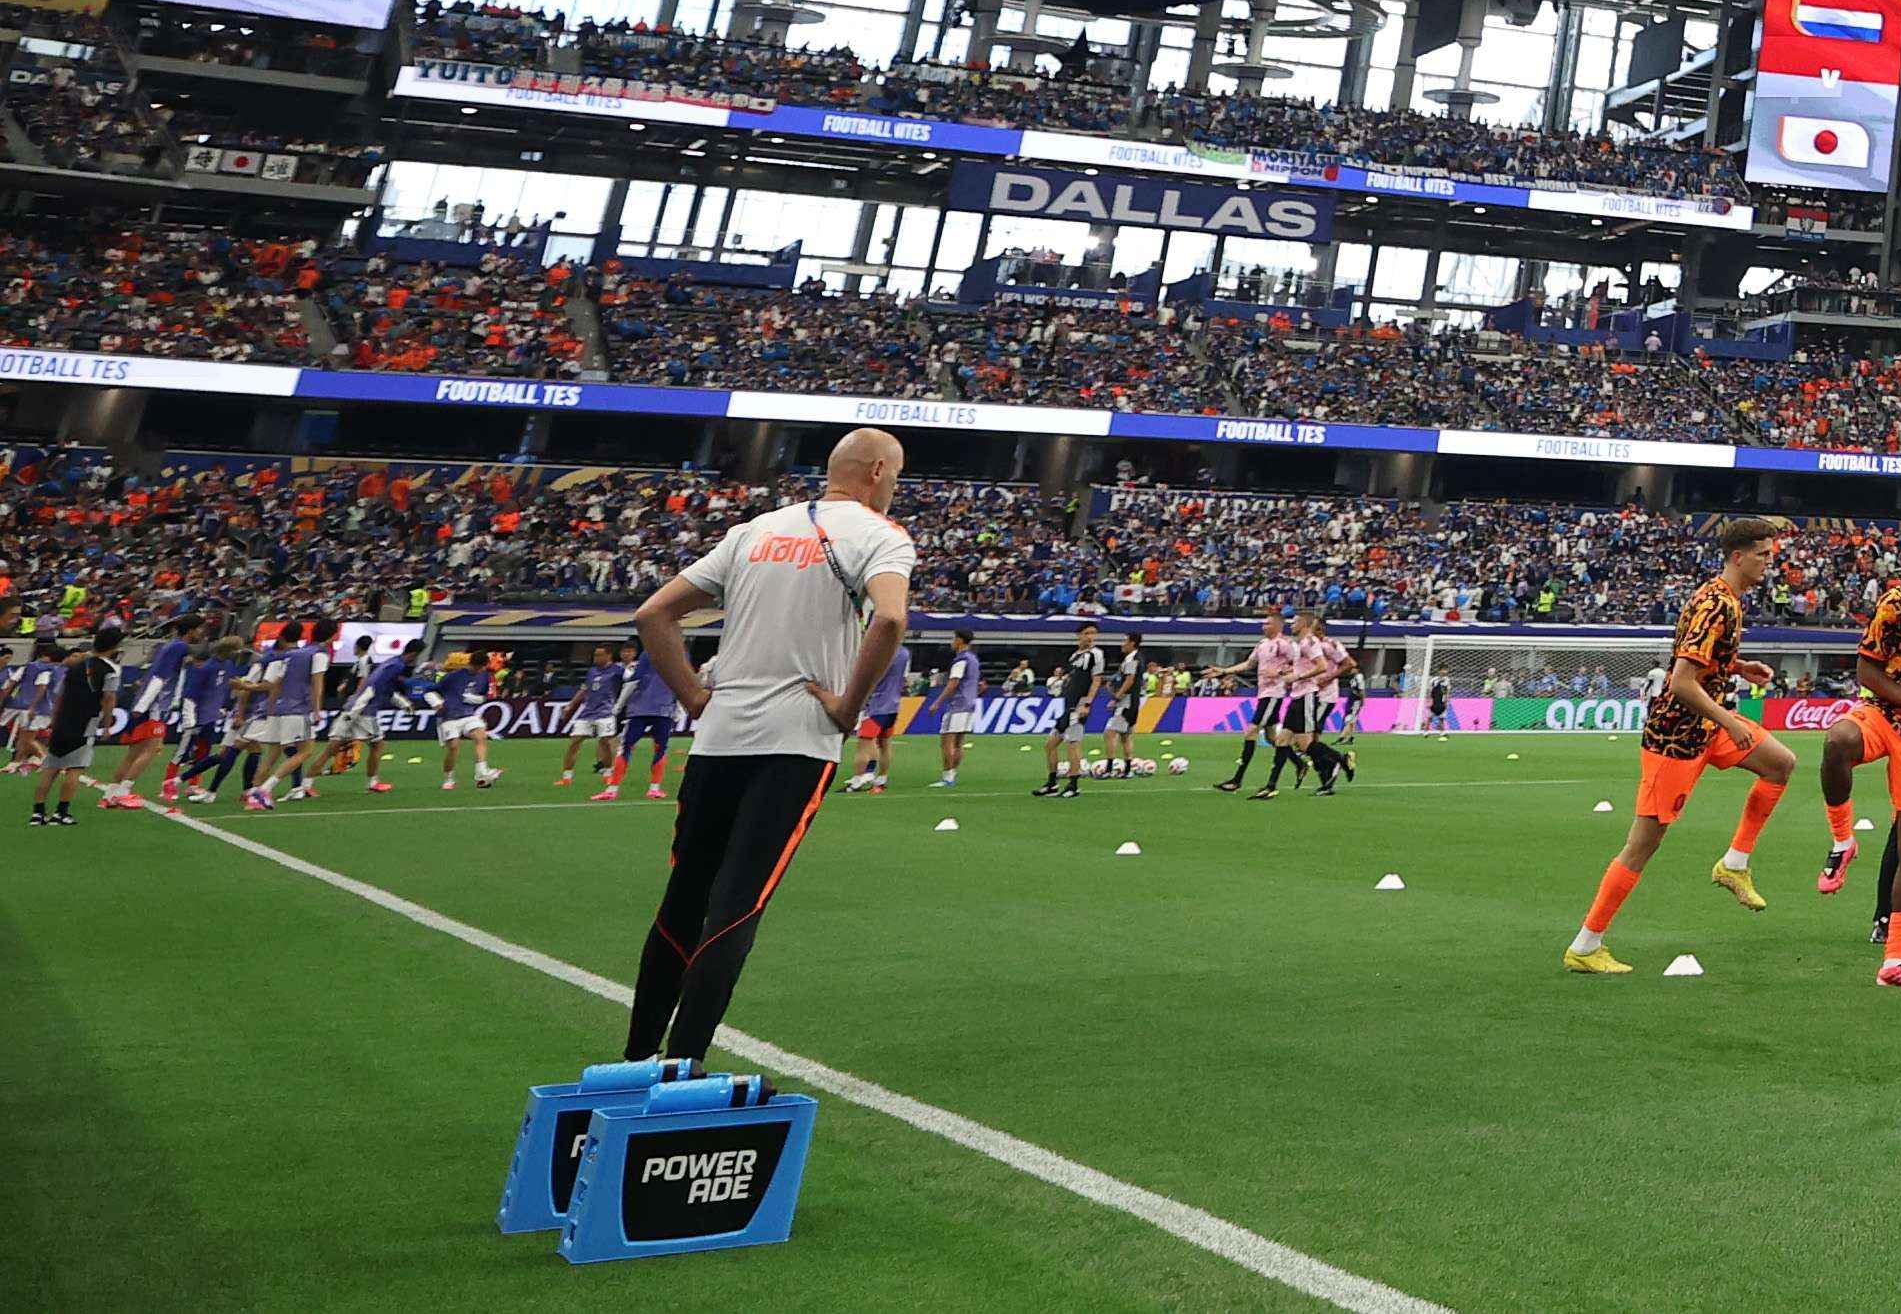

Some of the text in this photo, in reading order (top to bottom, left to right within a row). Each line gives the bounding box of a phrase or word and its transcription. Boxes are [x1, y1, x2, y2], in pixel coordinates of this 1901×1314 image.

[418, 60, 517, 84] YUITO
[823, 115, 891, 138] FOOTBALL
[1109, 145, 1169, 167] FOOTBALL
[1366, 172, 1422, 192] FOOTBALL
[989, 171, 1318, 237] DALLAS
[1602, 197, 1650, 214] FOOTBALL
[0, 353, 81, 377] OTBALL
[435, 379, 538, 405] FOOTBALL
[856, 402, 942, 424] FOOTBALL
[1216, 419, 1294, 442] FOOTBALL
[1536, 438, 1602, 456] FOOTBALL
[1818, 453, 1880, 472] FOOTBALL
[972, 697, 1066, 733] VISA
[641, 1149, 758, 1183] POWER
[687, 1174, 753, 1204] ADE
